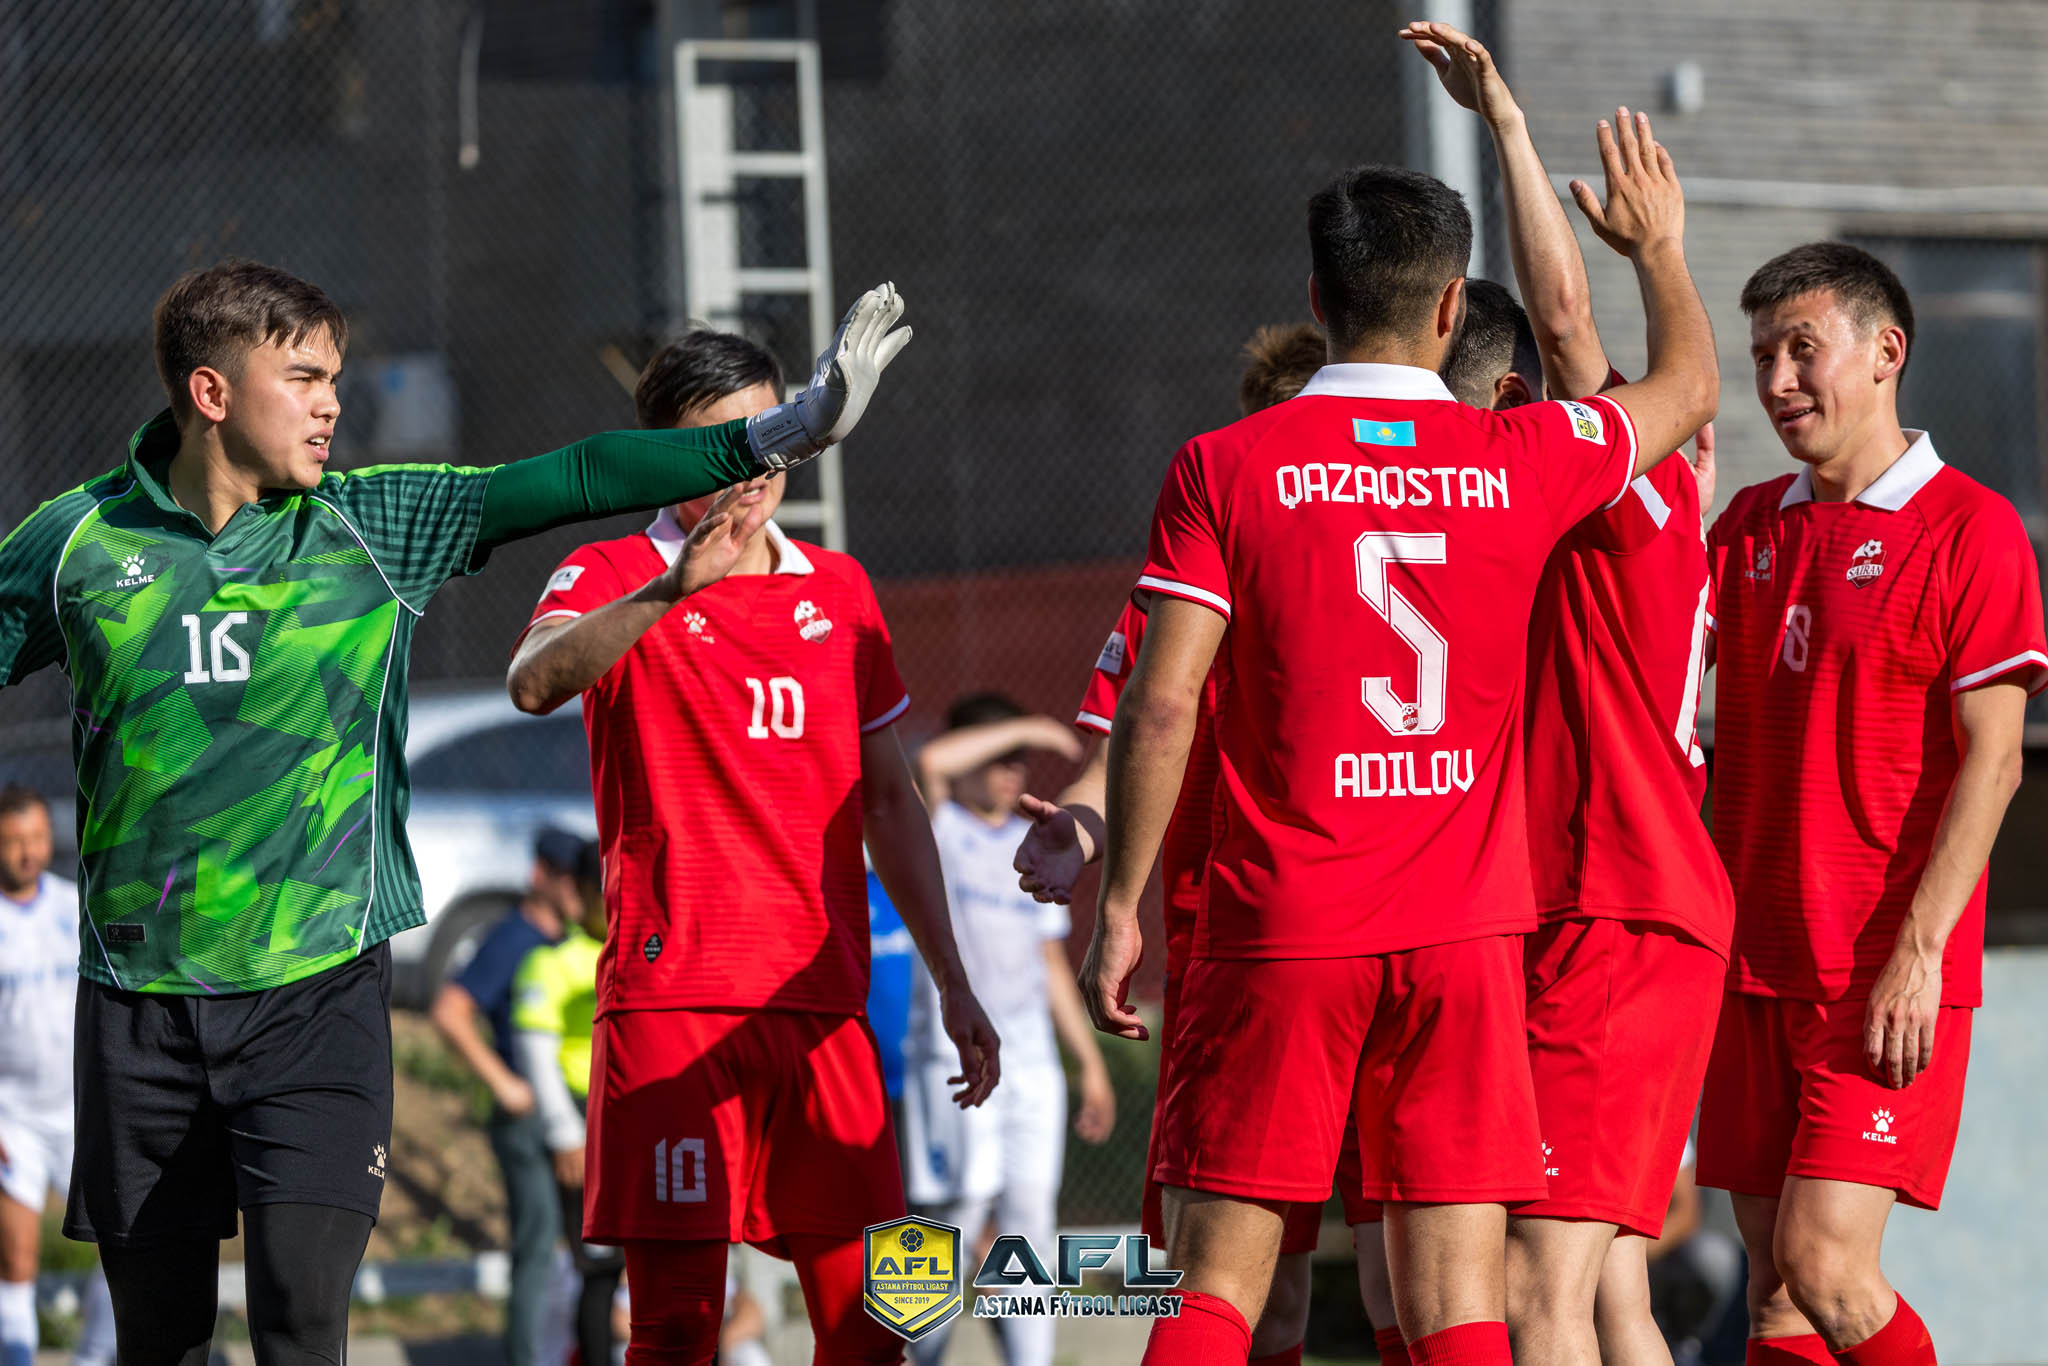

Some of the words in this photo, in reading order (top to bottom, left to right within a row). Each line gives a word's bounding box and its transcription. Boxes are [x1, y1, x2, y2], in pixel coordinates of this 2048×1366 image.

[1276, 463, 1510, 509] QAZAQSTAN
[116, 574, 155, 588] KELME
[1847, 564, 1882, 580] SAIRAN
[182, 612, 251, 684] 16
[1353, 531, 1448, 736] 5
[1783, 604, 1812, 672] 8
[746, 676, 805, 739] 10
[1335, 749, 1475, 798] ADILOV
[1862, 1131, 1897, 1144] KELME
[368, 1165, 385, 1180] KEL
[655, 1136, 707, 1202] 10
